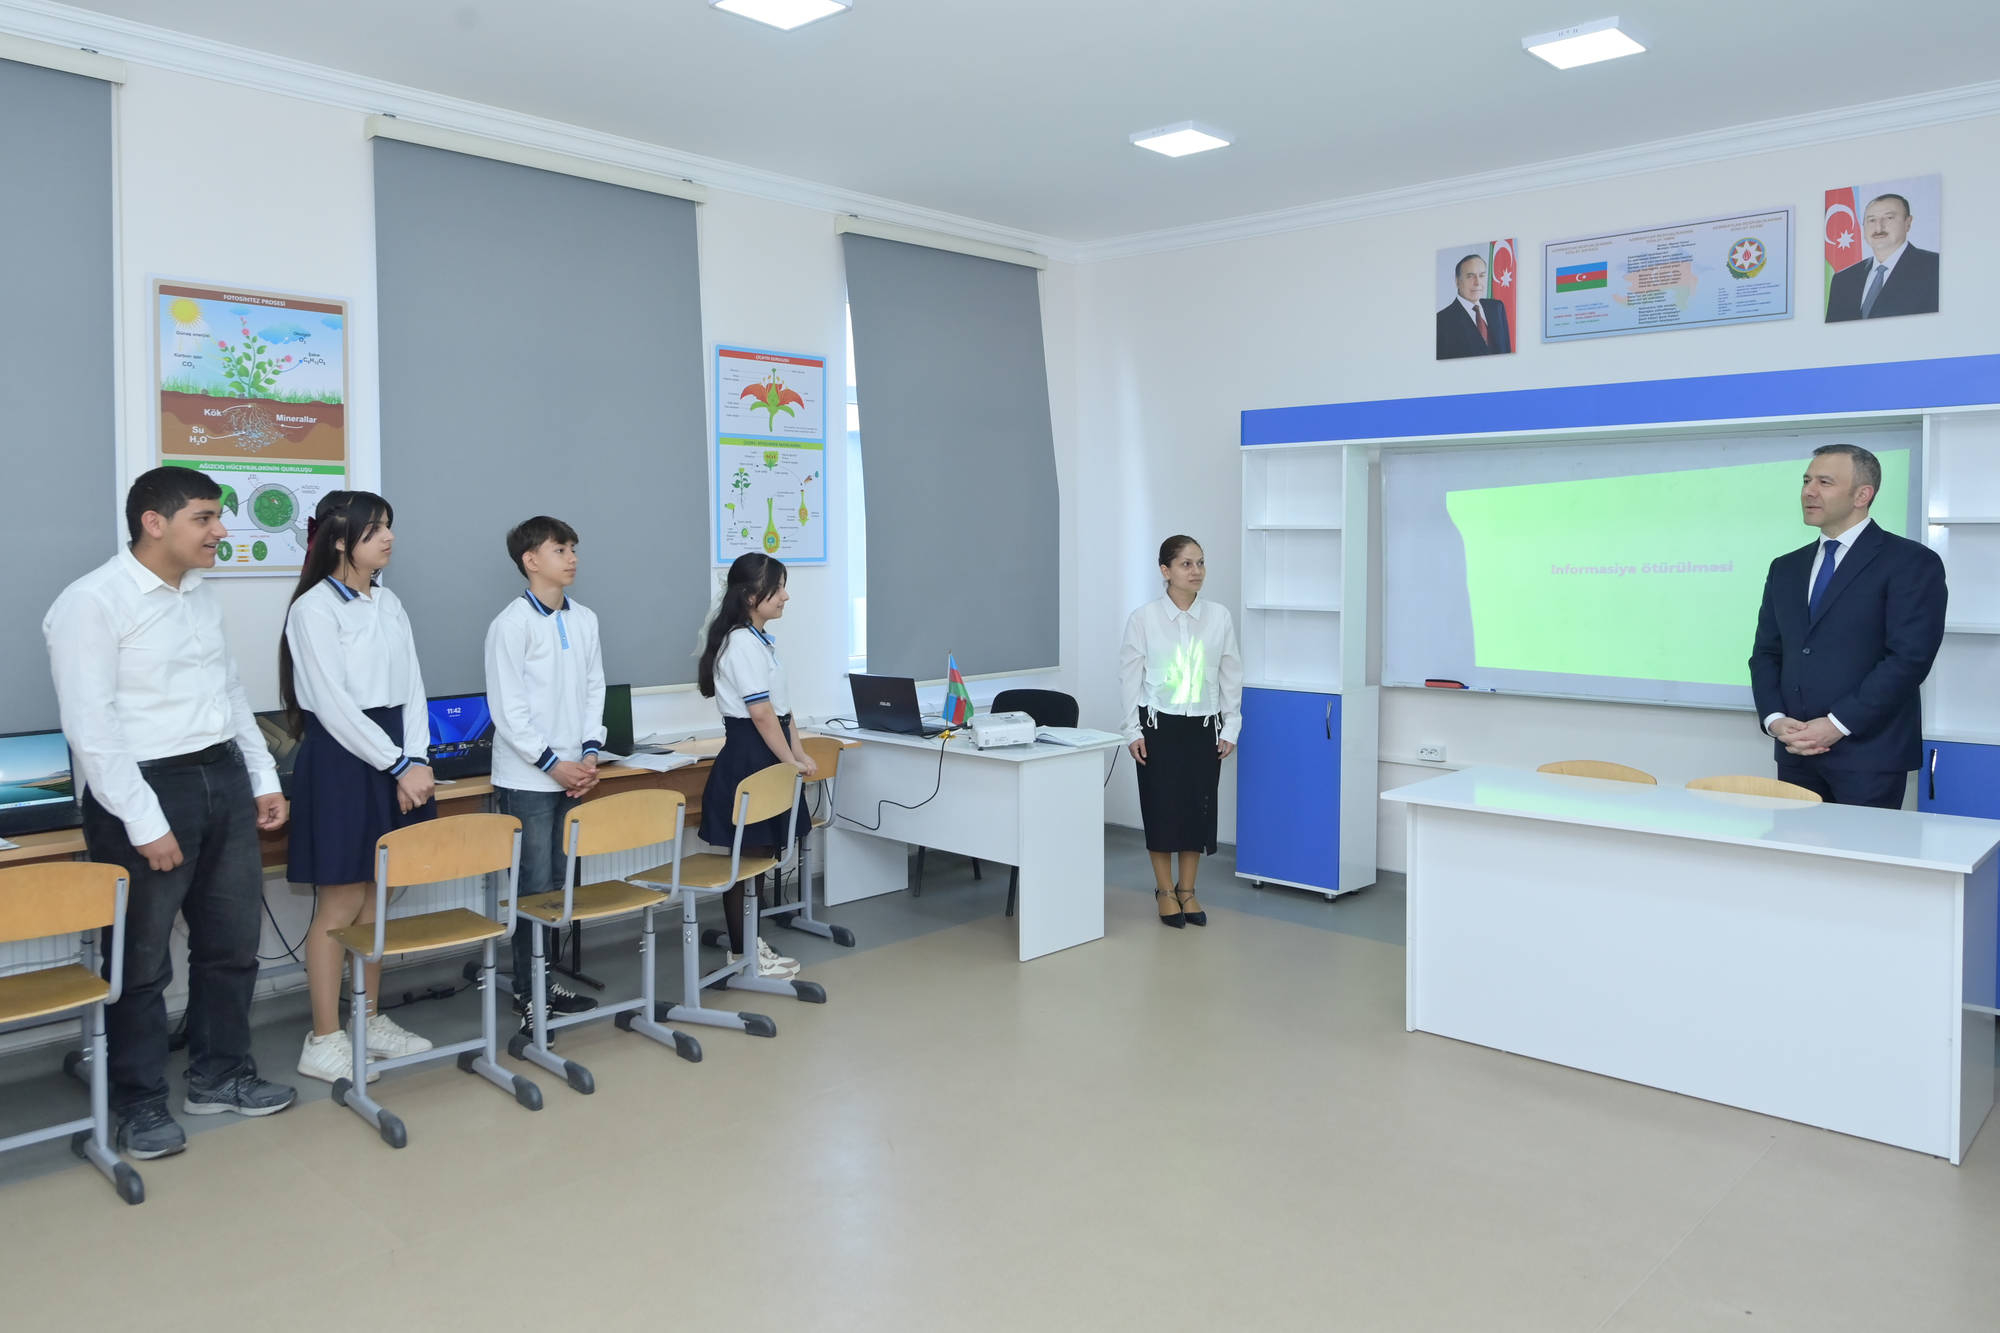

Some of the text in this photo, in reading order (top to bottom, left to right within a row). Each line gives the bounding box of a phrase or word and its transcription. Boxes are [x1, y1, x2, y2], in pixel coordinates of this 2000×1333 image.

[203, 409, 222, 417] Kök
[276, 414, 318, 423] Minerallar
[192, 426, 205, 434] Su
